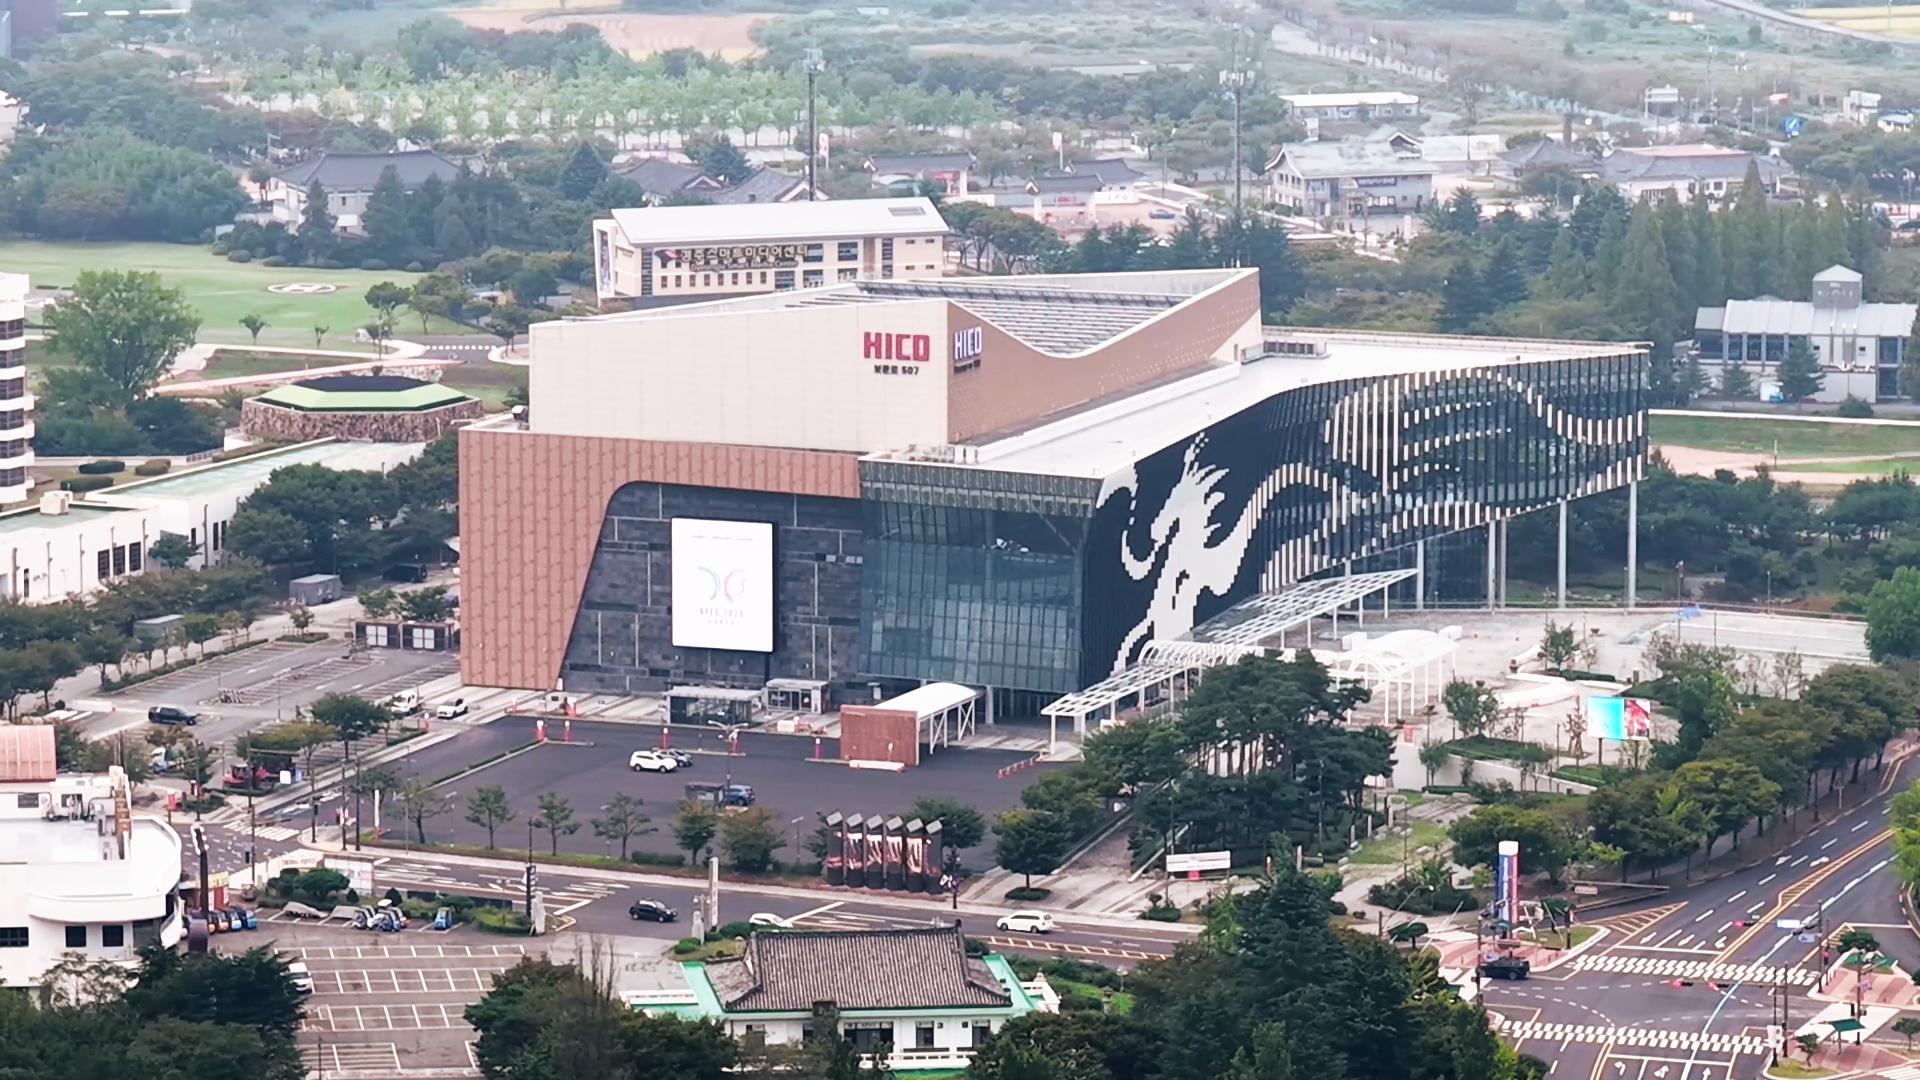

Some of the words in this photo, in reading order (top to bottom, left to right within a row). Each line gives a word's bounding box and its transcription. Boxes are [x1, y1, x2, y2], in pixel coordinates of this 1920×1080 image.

[681, 244, 808, 262] 경주스마트미디어센터
[863, 332, 930, 362] HICO
[954, 326, 982, 360] HICO
[902, 366, 919, 375] 507
